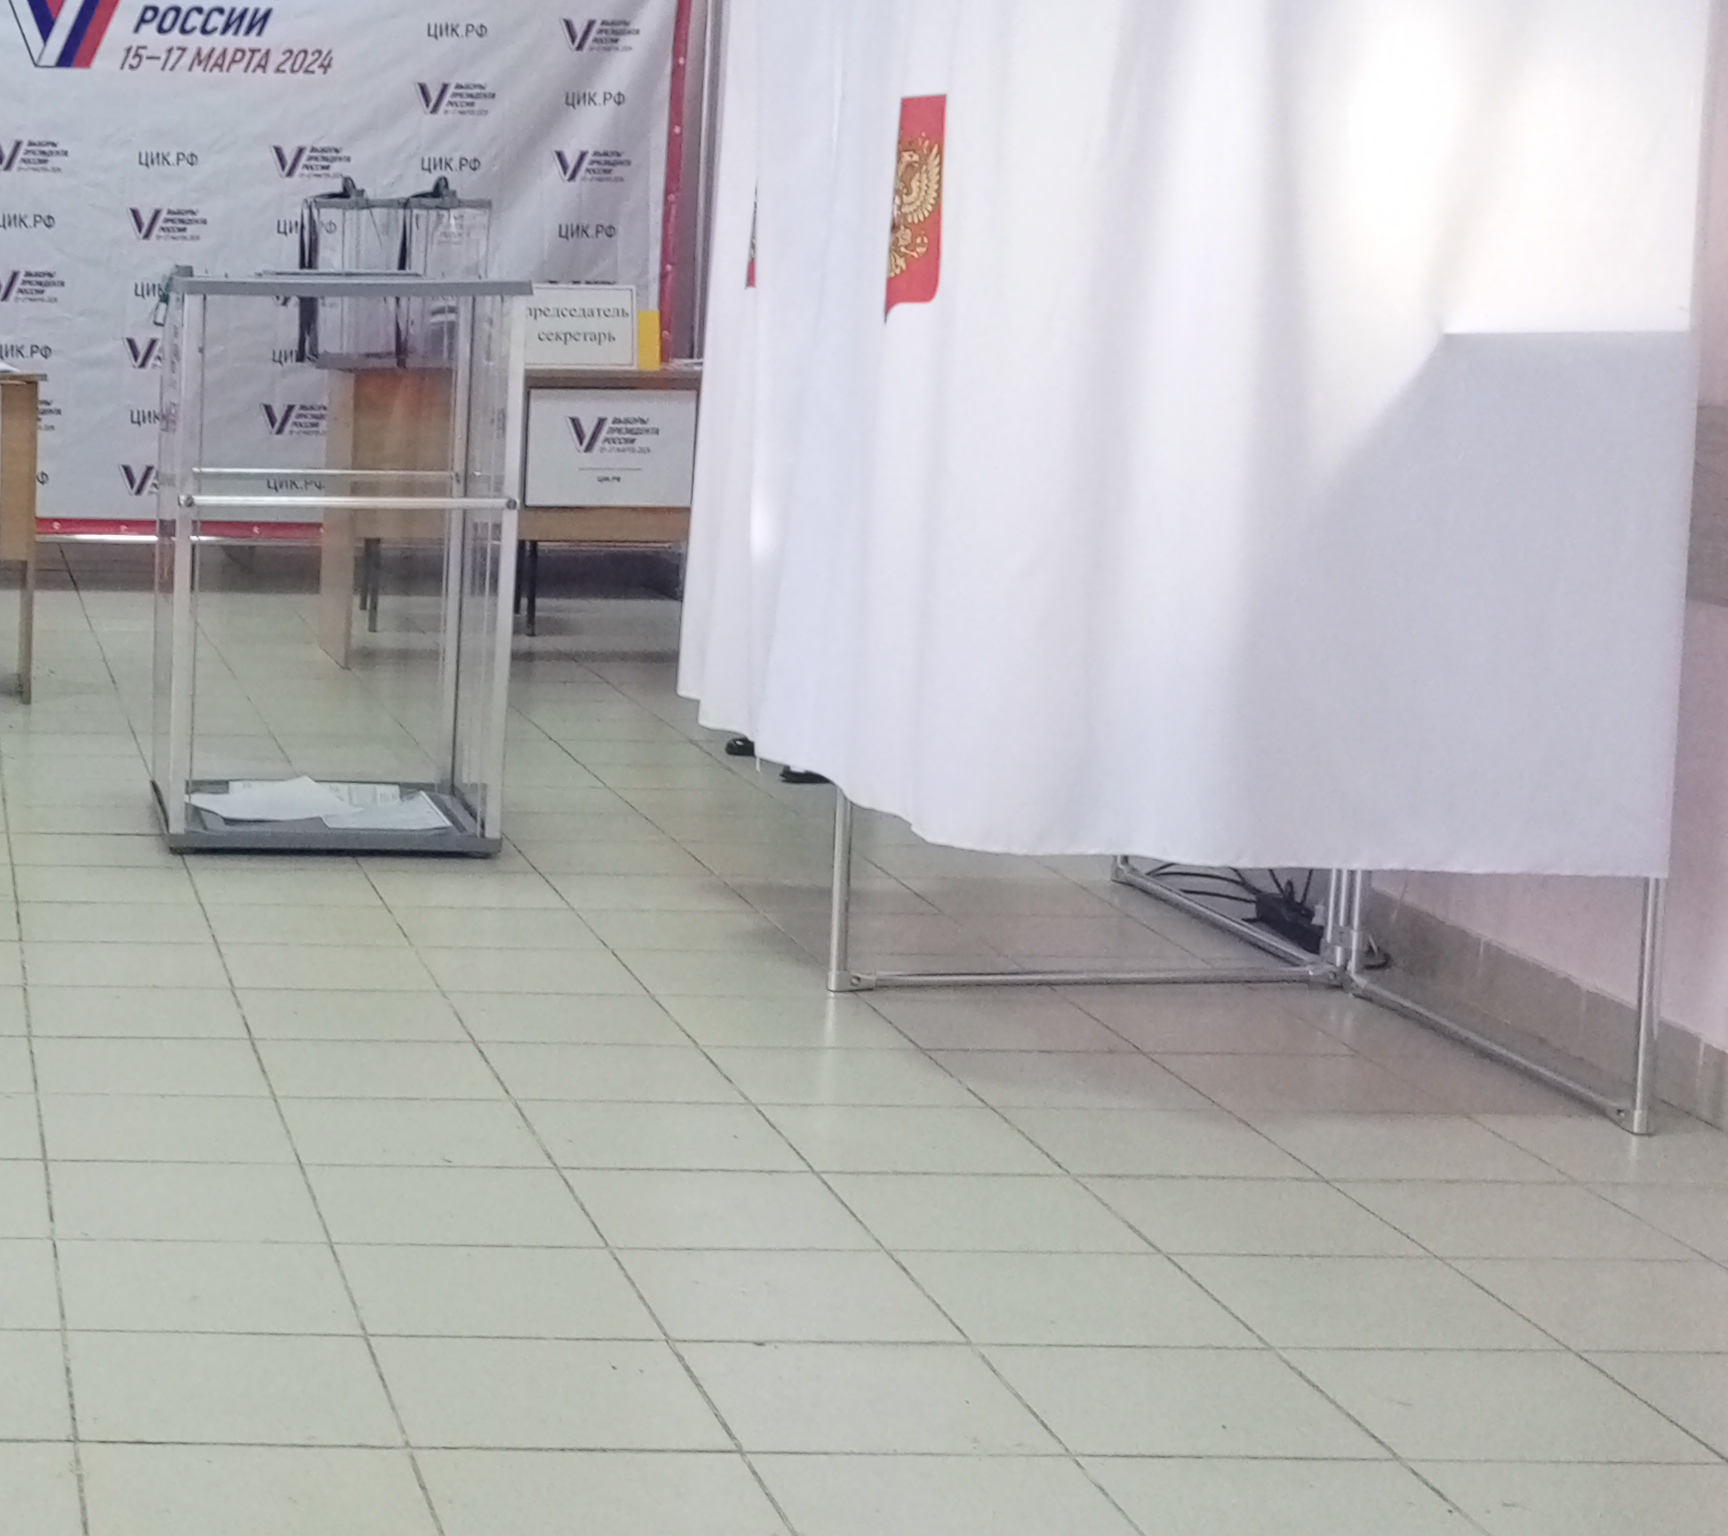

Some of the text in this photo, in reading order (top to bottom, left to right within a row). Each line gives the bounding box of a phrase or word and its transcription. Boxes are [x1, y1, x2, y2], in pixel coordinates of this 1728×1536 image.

[133, 5, 273, 37] РОССИИ
[426, 22, 488, 41] ЦИК.РФ
[188, 46, 272, 74] МАРТА
[274, 47, 333, 74] 2024
[565, 91, 626, 109] ЦИК.РФ
[138, 151, 199, 169] ЦИК.РФ
[420, 156, 481, 174] ЦИК.РФ
[558, 223, 617, 241] ЦИК.РФ
[537, 329, 616, 346] секретарь
